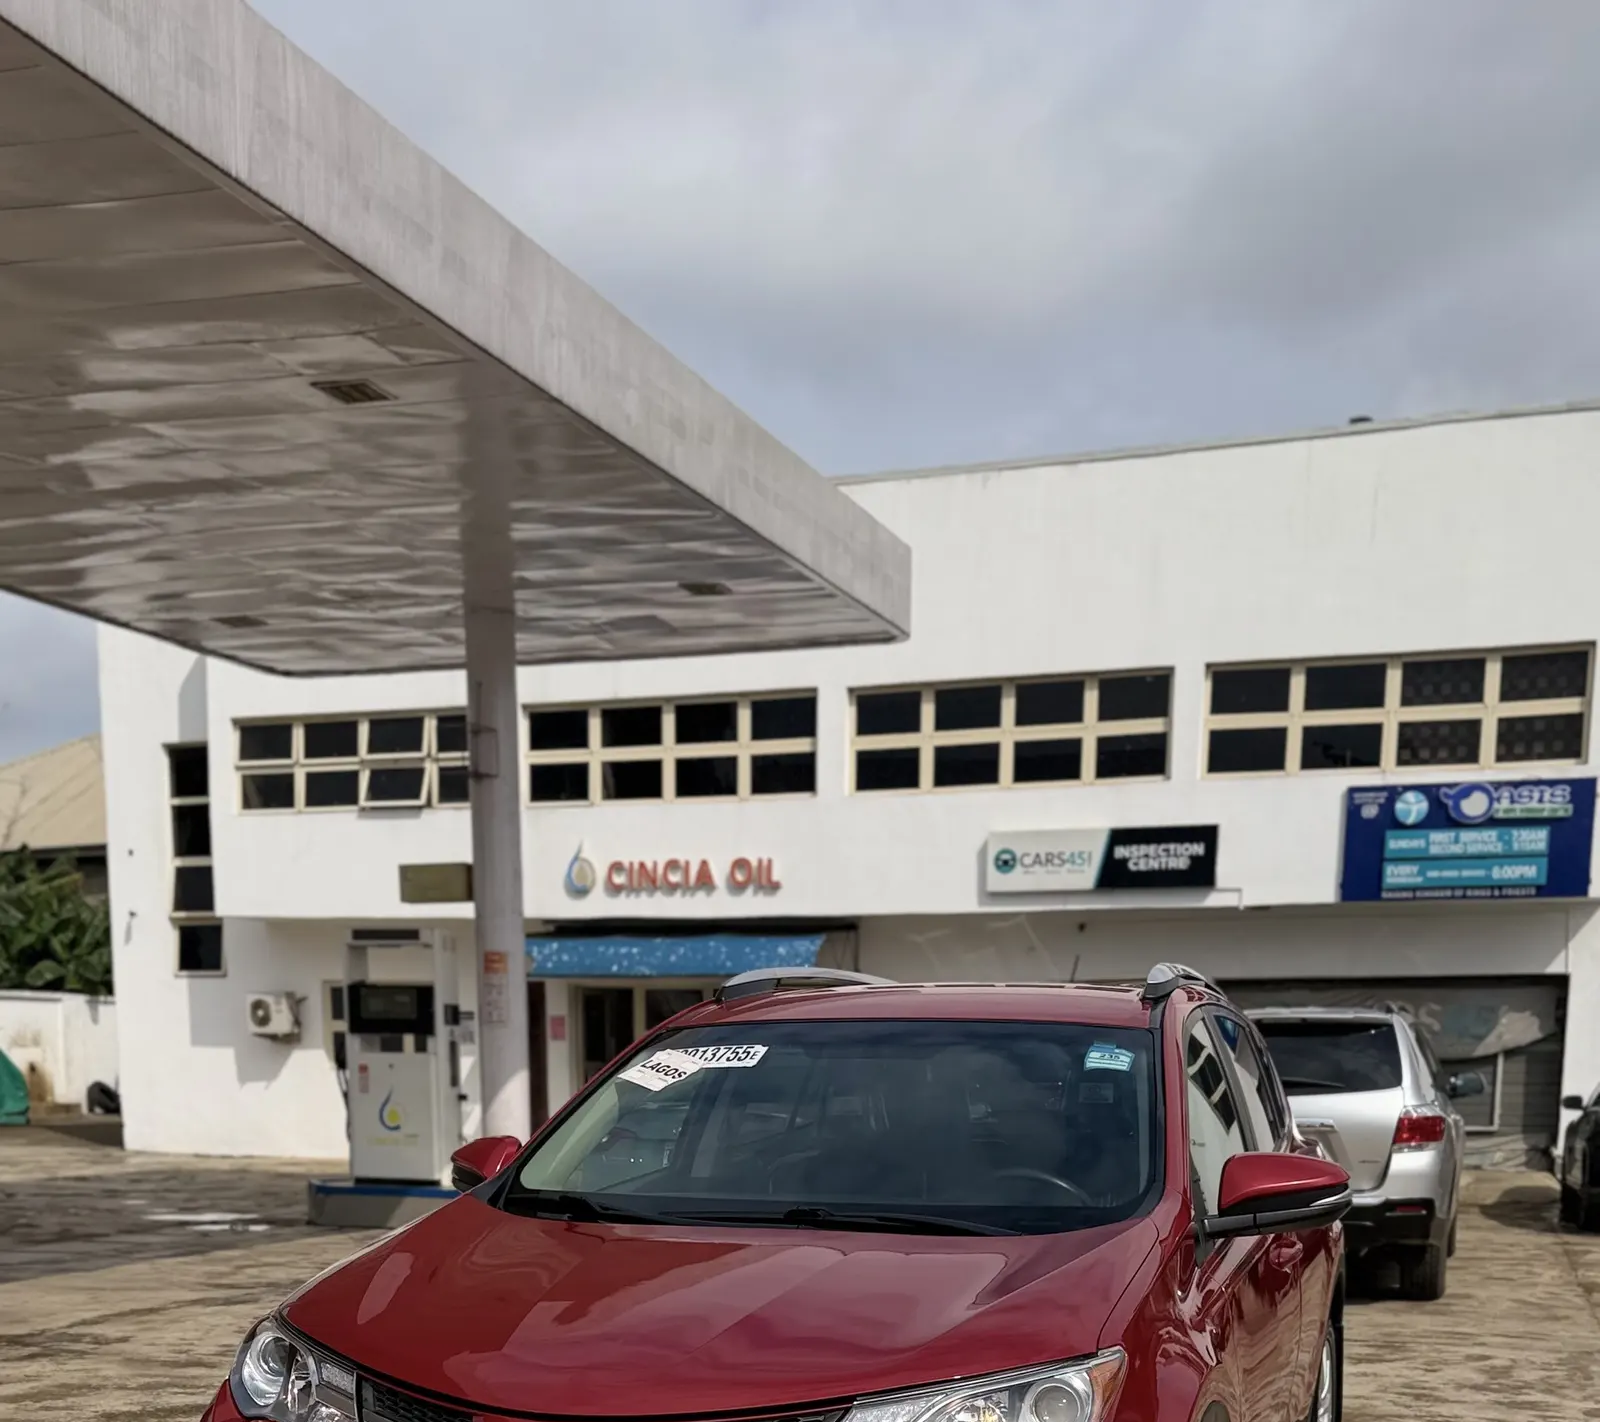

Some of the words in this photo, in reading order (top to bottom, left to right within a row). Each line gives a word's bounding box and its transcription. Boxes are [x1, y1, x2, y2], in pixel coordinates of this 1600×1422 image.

[1459, 830, 1497, 843] SERVICE
[1113, 842, 1205, 860] INSPECTION
[1127, 856, 1191, 872] CENTRE
[1386, 865, 1419, 877] EVERY
[606, 859, 716, 890] CINCIA
[730, 857, 782, 889] OIL
[640, 1060, 687, 1079] LAGOS
